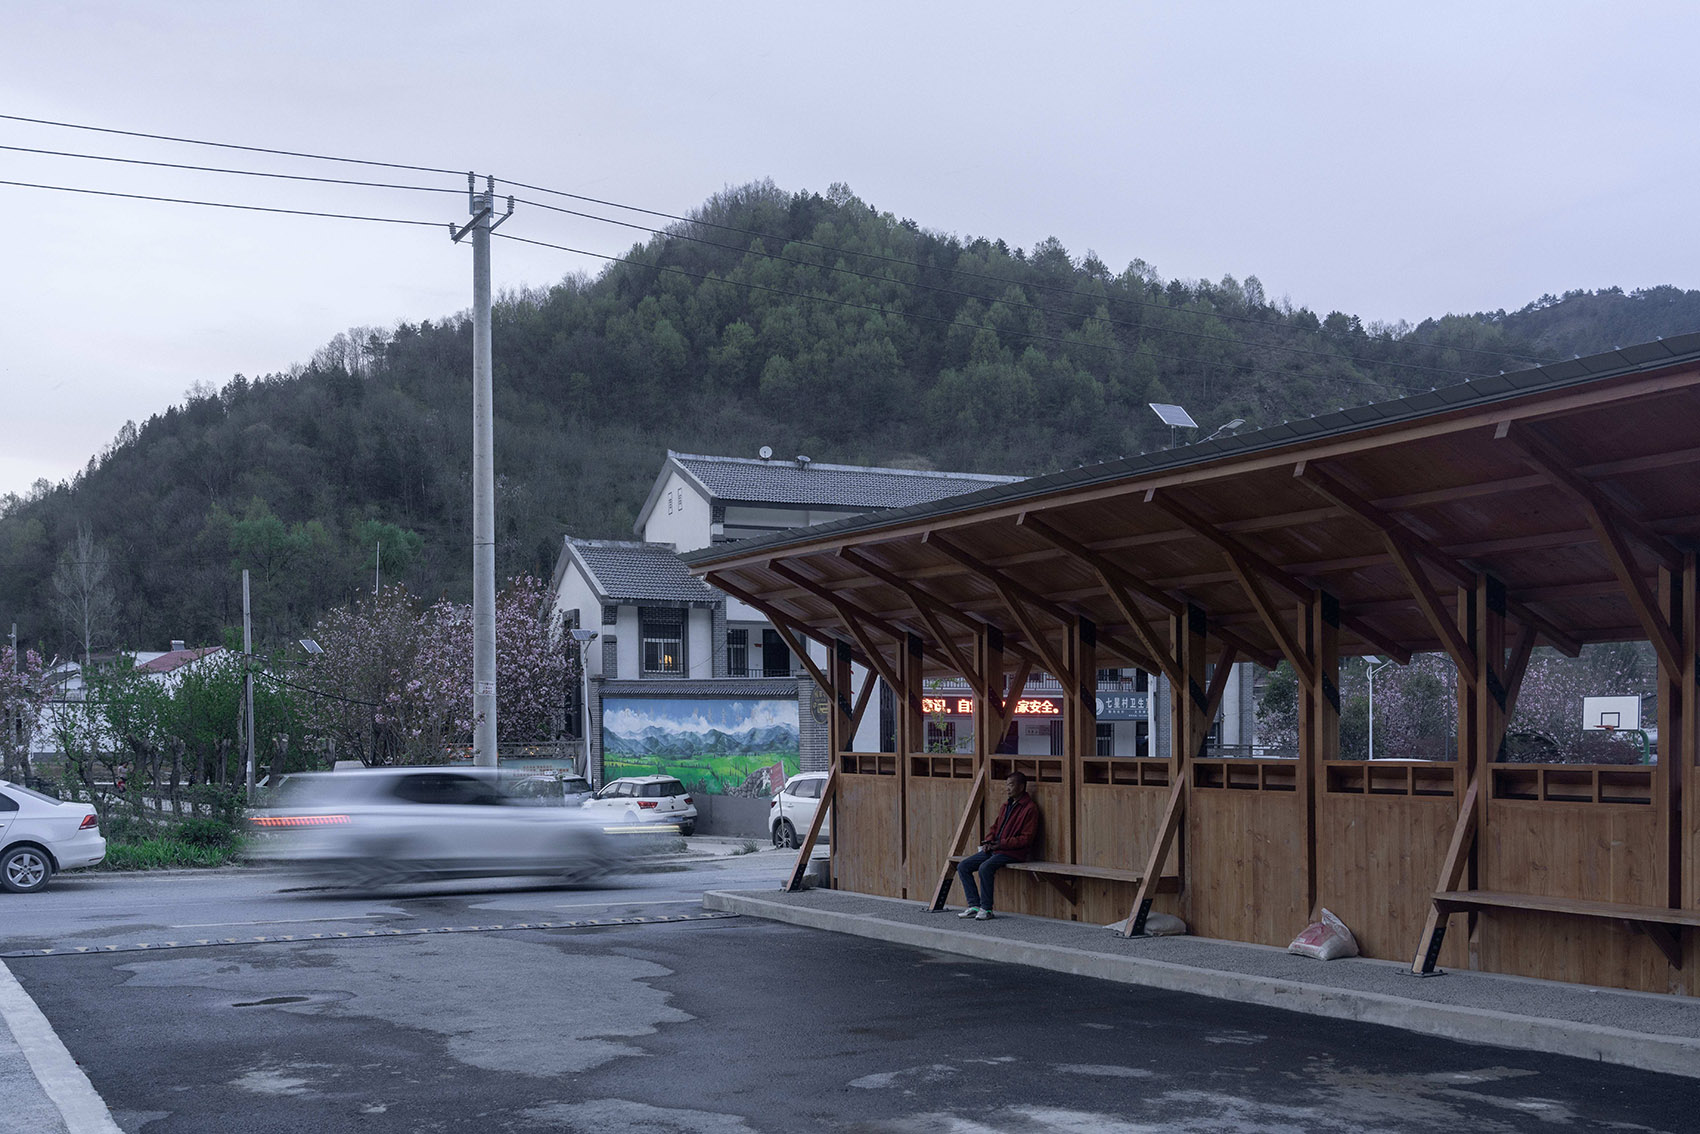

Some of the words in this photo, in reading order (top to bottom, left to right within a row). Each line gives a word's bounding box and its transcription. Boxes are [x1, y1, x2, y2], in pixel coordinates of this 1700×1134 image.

[922, 698, 973, 714] 意识，自
[1105, 697, 1148, 709] 七星村卫生
